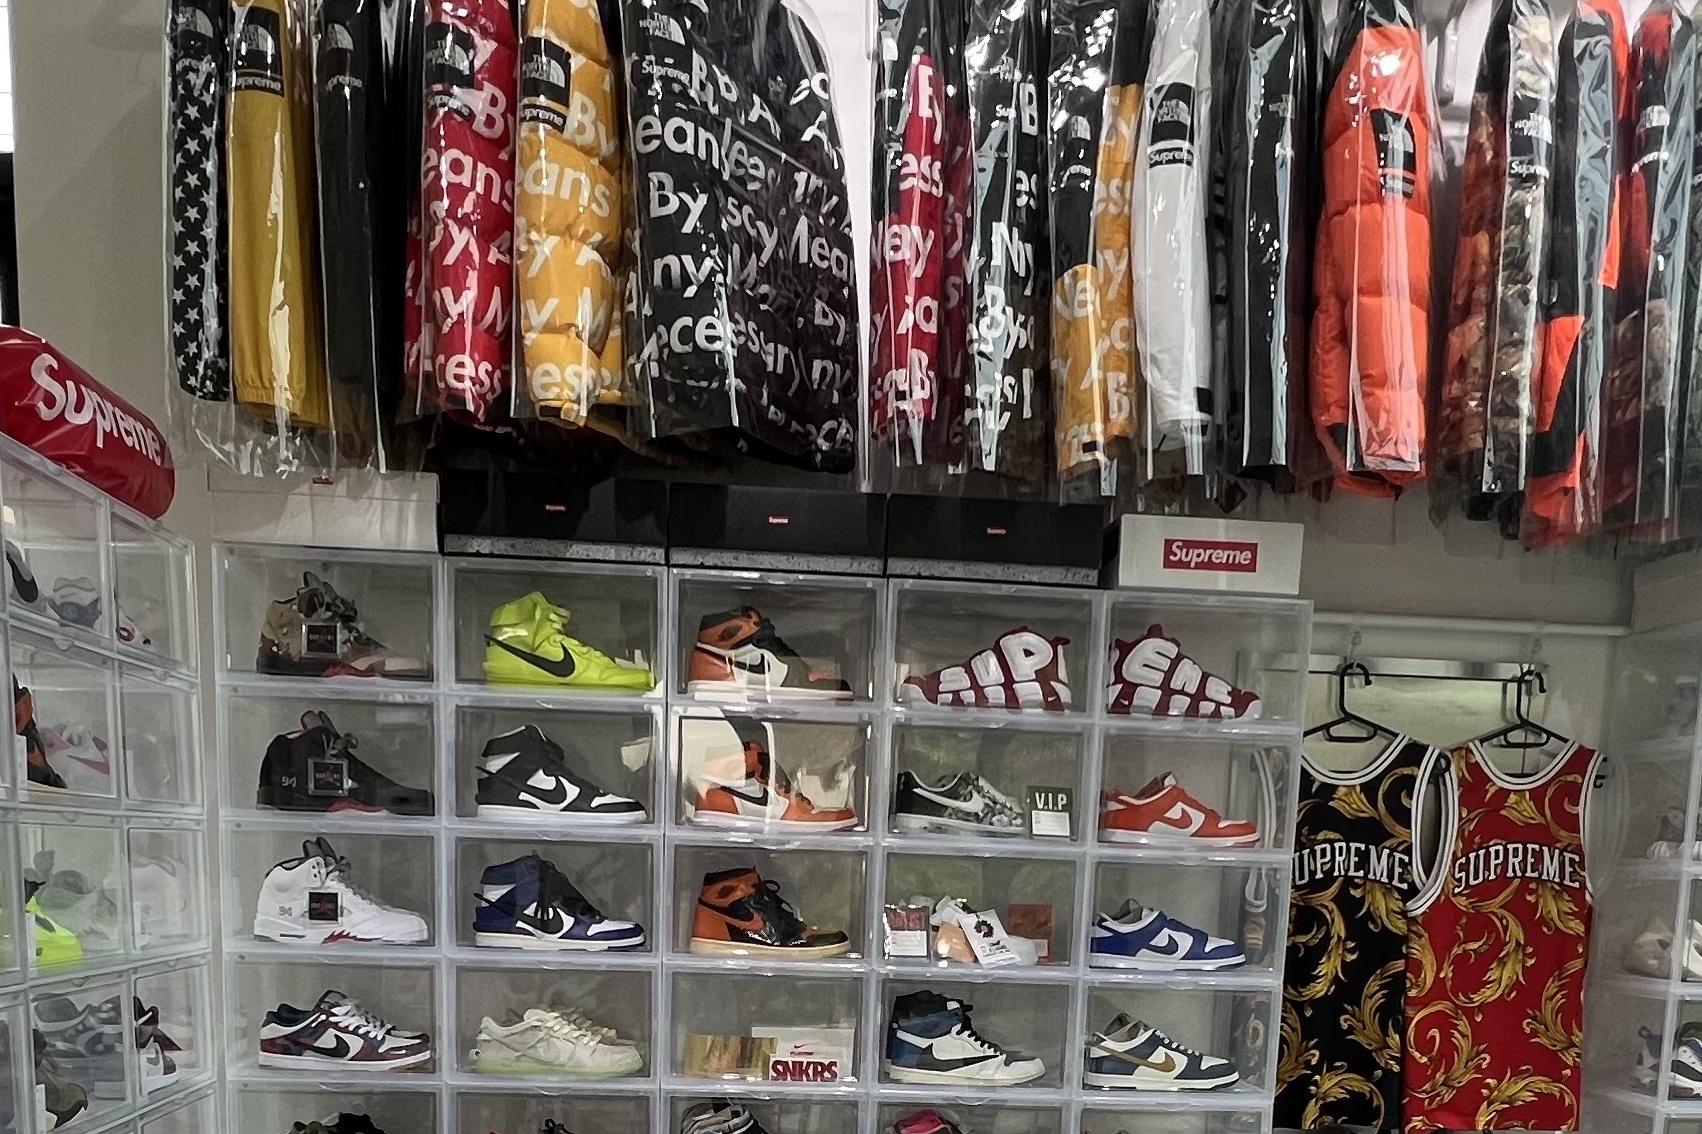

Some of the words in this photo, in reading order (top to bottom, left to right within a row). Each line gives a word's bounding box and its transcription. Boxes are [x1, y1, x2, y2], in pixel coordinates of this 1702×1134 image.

[521, 107, 564, 127] upreme
[648, 172, 709, 234] By
[31, 353, 162, 466] Supreme
[1169, 541, 1252, 568] Supreme
[1293, 842, 1410, 890] UPREME
[1453, 842, 1581, 894] SUPREME
[771, 1060, 838, 1082] SNKRS
